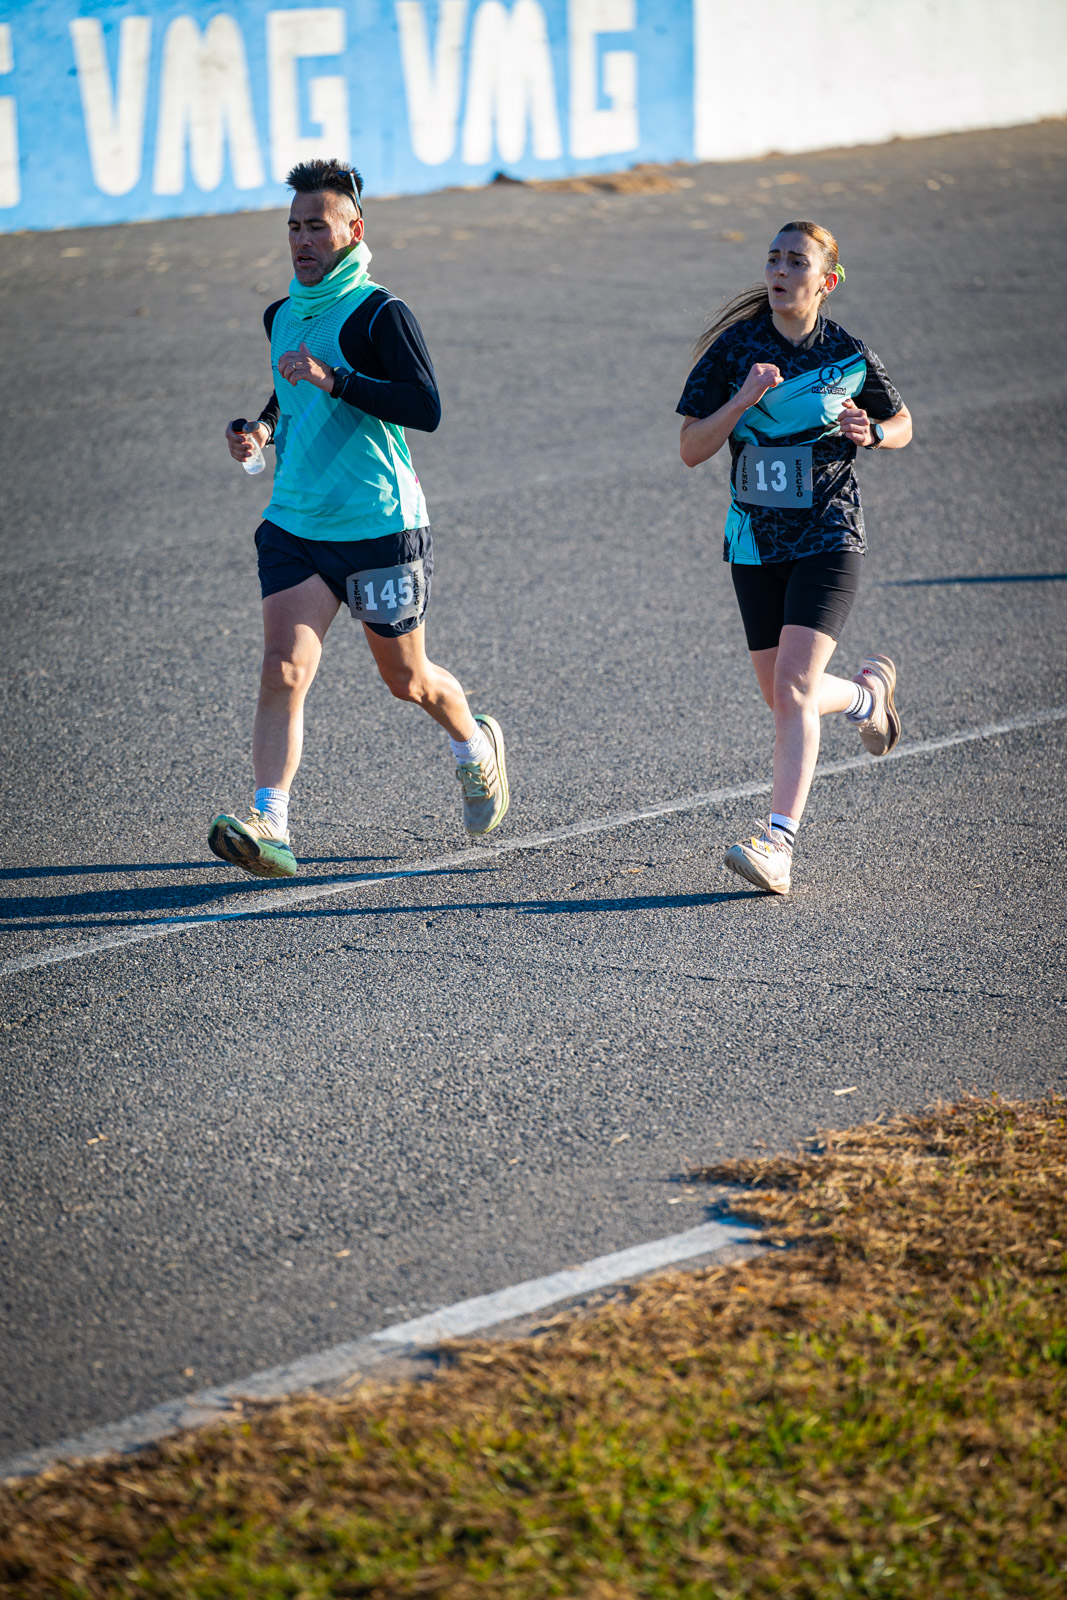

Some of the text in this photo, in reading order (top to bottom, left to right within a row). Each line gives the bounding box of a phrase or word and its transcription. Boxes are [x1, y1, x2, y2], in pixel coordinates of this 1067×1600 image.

[69, 8, 351, 196] VMG
[396, 0, 640, 166] VMG
[756, 460, 787, 492] 13
[795, 459, 803, 497] EXACTO
[364, 575, 413, 611] 145
